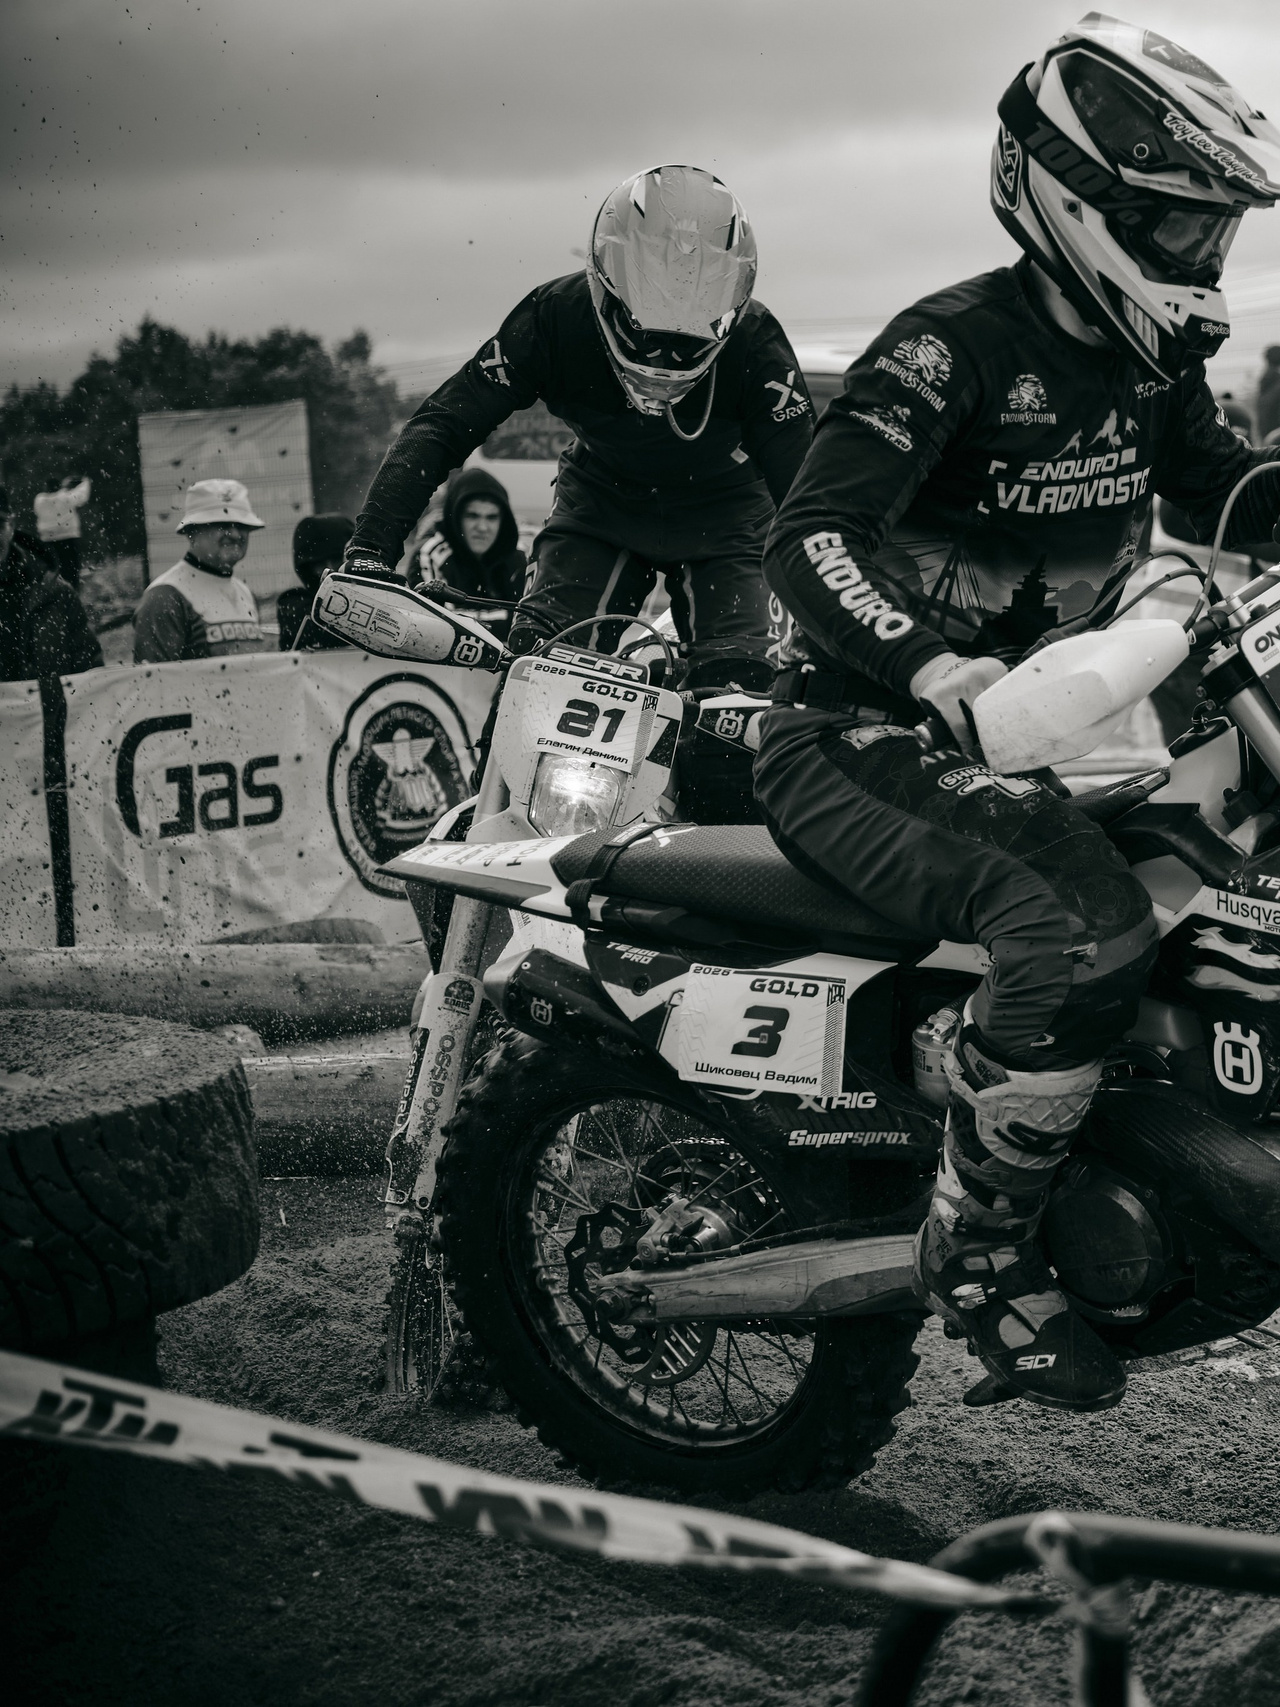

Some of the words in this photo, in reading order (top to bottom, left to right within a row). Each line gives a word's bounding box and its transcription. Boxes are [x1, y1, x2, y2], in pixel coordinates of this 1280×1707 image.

[1165, 112, 1192, 140] Troy
[802, 530, 914, 641] ENDURO
[548, 647, 643, 681] SCAR
[581, 680, 638, 703] GOLD
[556, 698, 626, 744] 21
[536, 737, 582, 754] Елагин
[581, 745, 629, 765] Даниил
[620, 951, 653, 966] PRO
[749, 978, 820, 1000] GOLD
[731, 1005, 790, 1059] 3
[694, 1062, 760, 1082] Шиковец
[764, 1069, 818, 1086] Вадим
[788, 1129, 912, 1148] Supersprox
